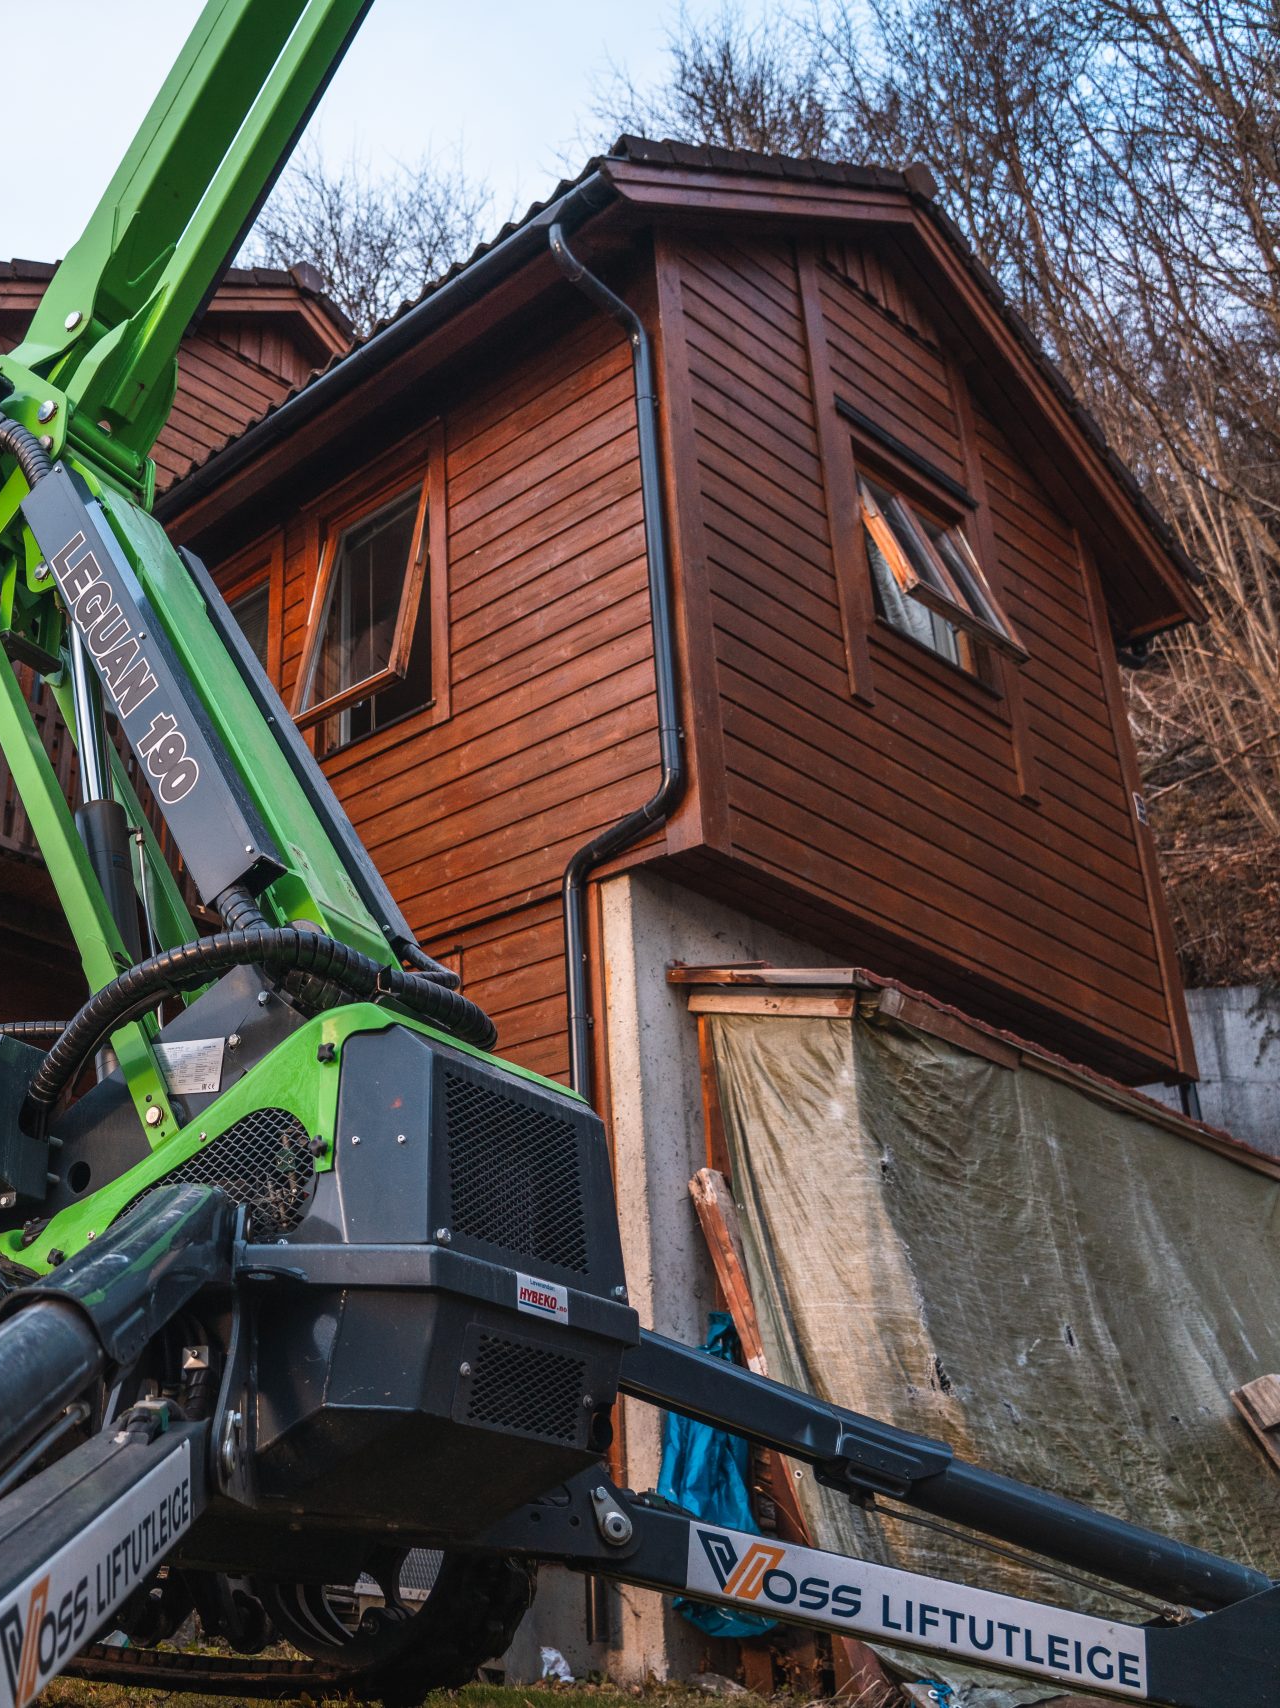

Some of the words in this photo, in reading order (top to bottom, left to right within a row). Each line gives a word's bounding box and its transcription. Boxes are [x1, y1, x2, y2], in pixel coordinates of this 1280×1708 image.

[50, 530, 159, 719] LEGUAN
[136, 711, 199, 804] 190
[95, 1478, 190, 1617] LIFTUTLEIGE
[696, 1529, 862, 1618] VOSS
[881, 1594, 1141, 1690] LIFTUTLEIGE
